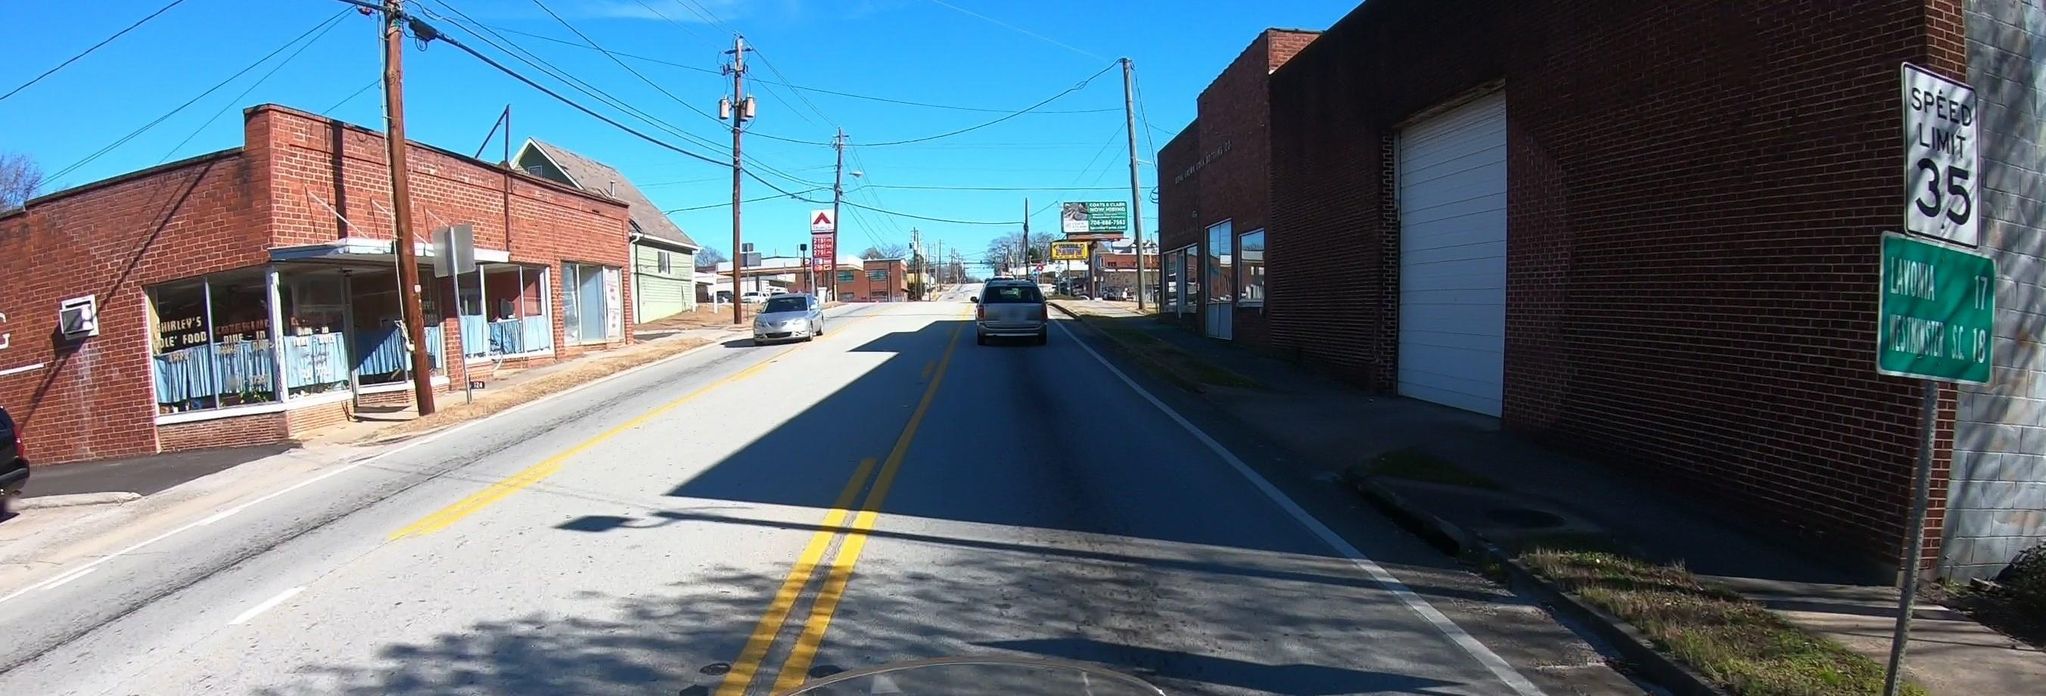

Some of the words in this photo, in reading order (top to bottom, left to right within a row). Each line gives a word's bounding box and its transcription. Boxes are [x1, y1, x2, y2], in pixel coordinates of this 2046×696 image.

[1911, 87, 1972, 127] SPEED
[1918, 122, 1966, 158] LIMIT
[1916, 157, 1971, 225] 35
[1890, 256, 1935, 301] LAVONIA
[1974, 275, 1988, 310] 17
[182, 331, 207, 345] FOOD
[1889, 314, 1945, 357] WESTMINSTER
[1973, 327, 1986, 363] 18
